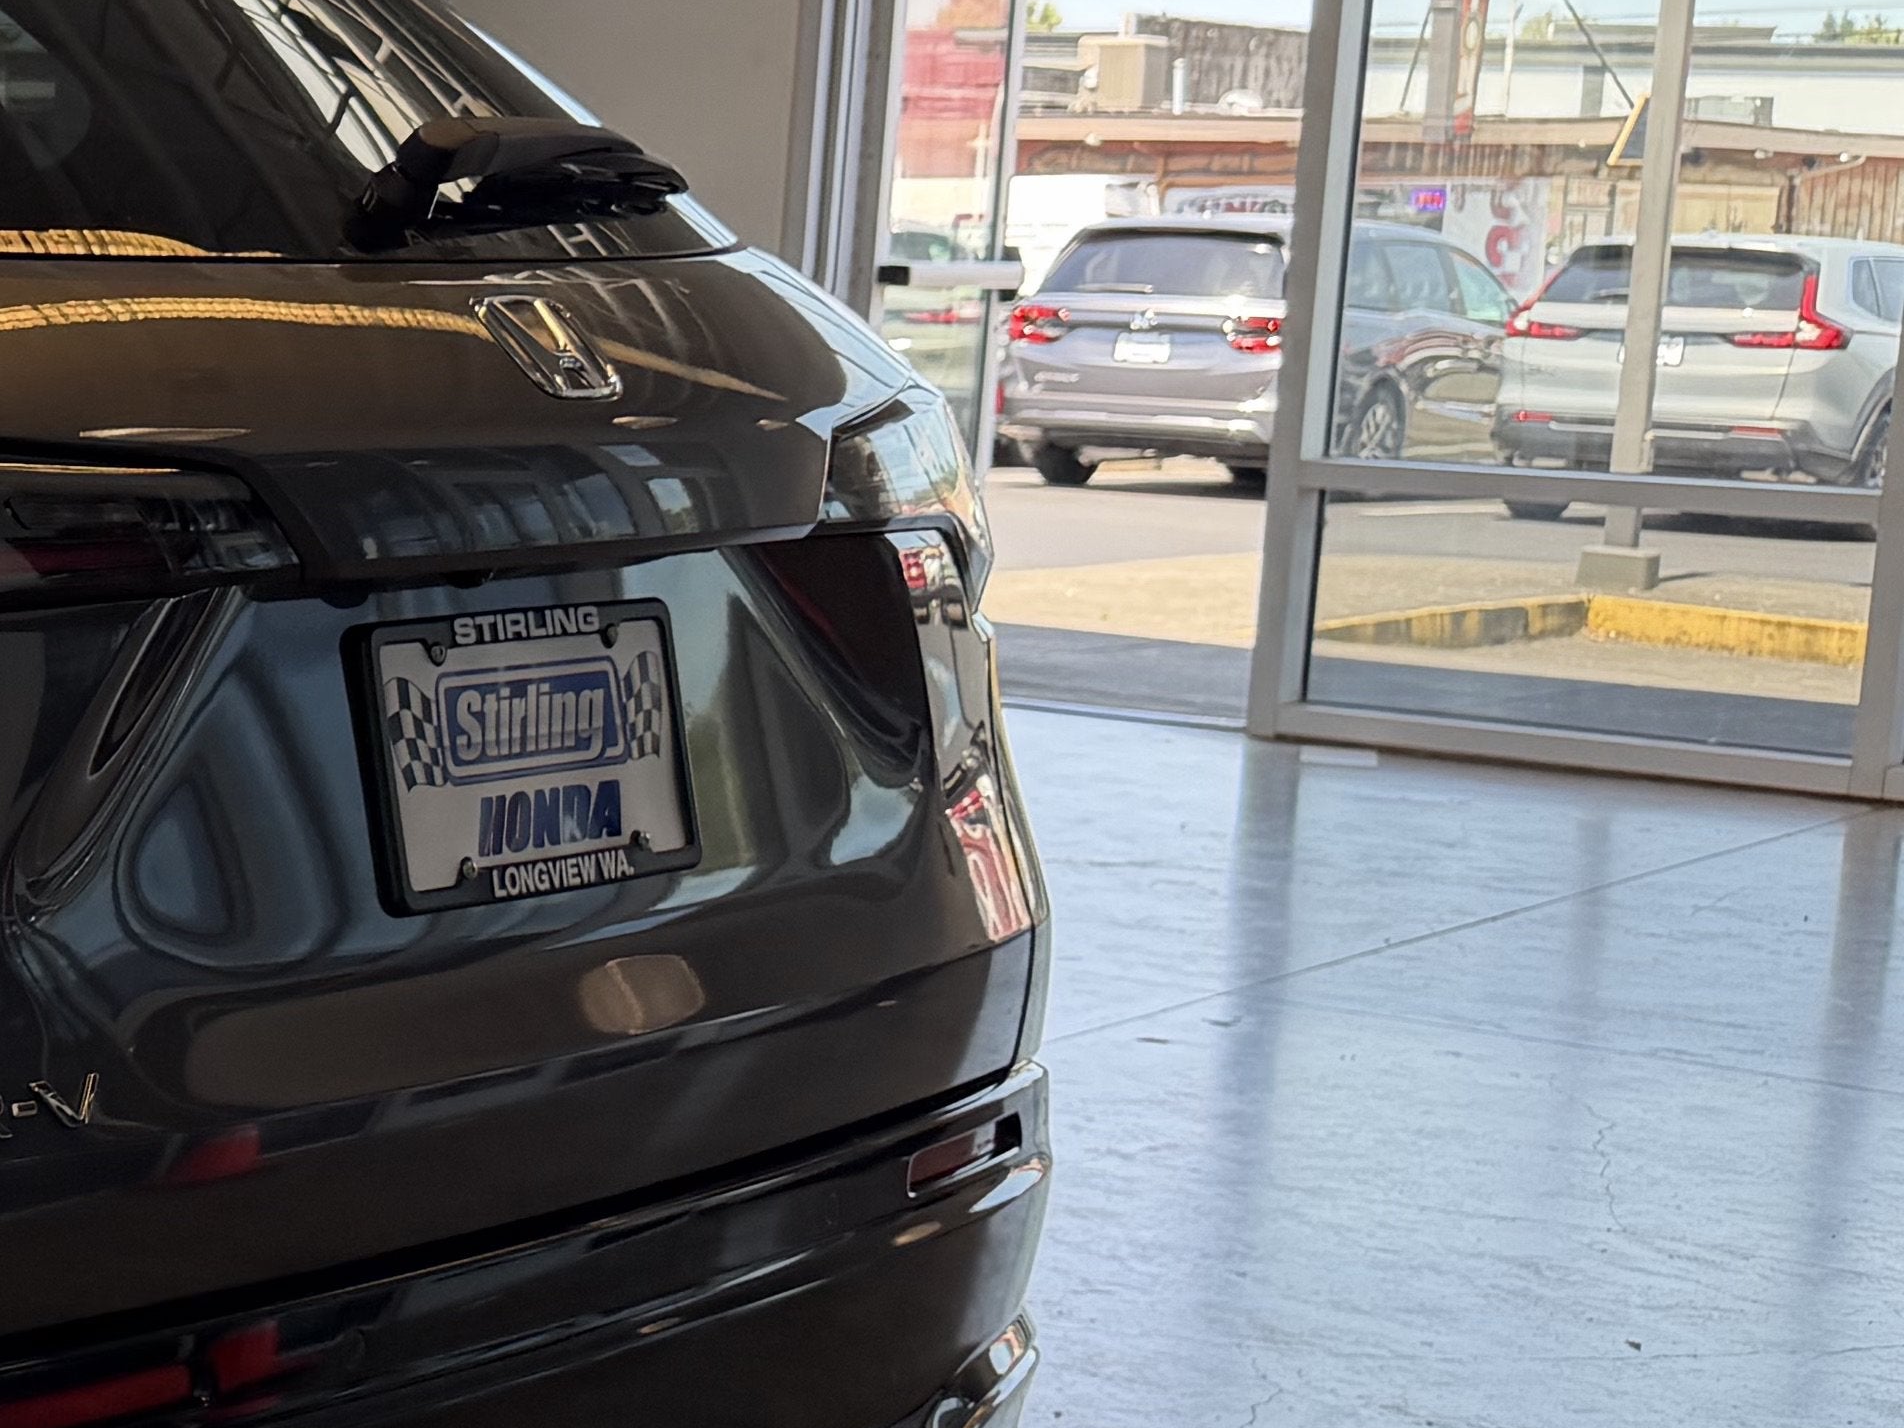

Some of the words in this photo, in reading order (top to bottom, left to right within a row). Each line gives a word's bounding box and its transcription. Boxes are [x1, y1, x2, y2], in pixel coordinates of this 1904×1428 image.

[453, 605, 601, 645] STIRLING
[455, 682, 605, 760] Stirling
[478, 779, 622, 857] HONDA
[492, 853, 596, 898] LONGVIEW
[596, 849, 635, 880] WA.
